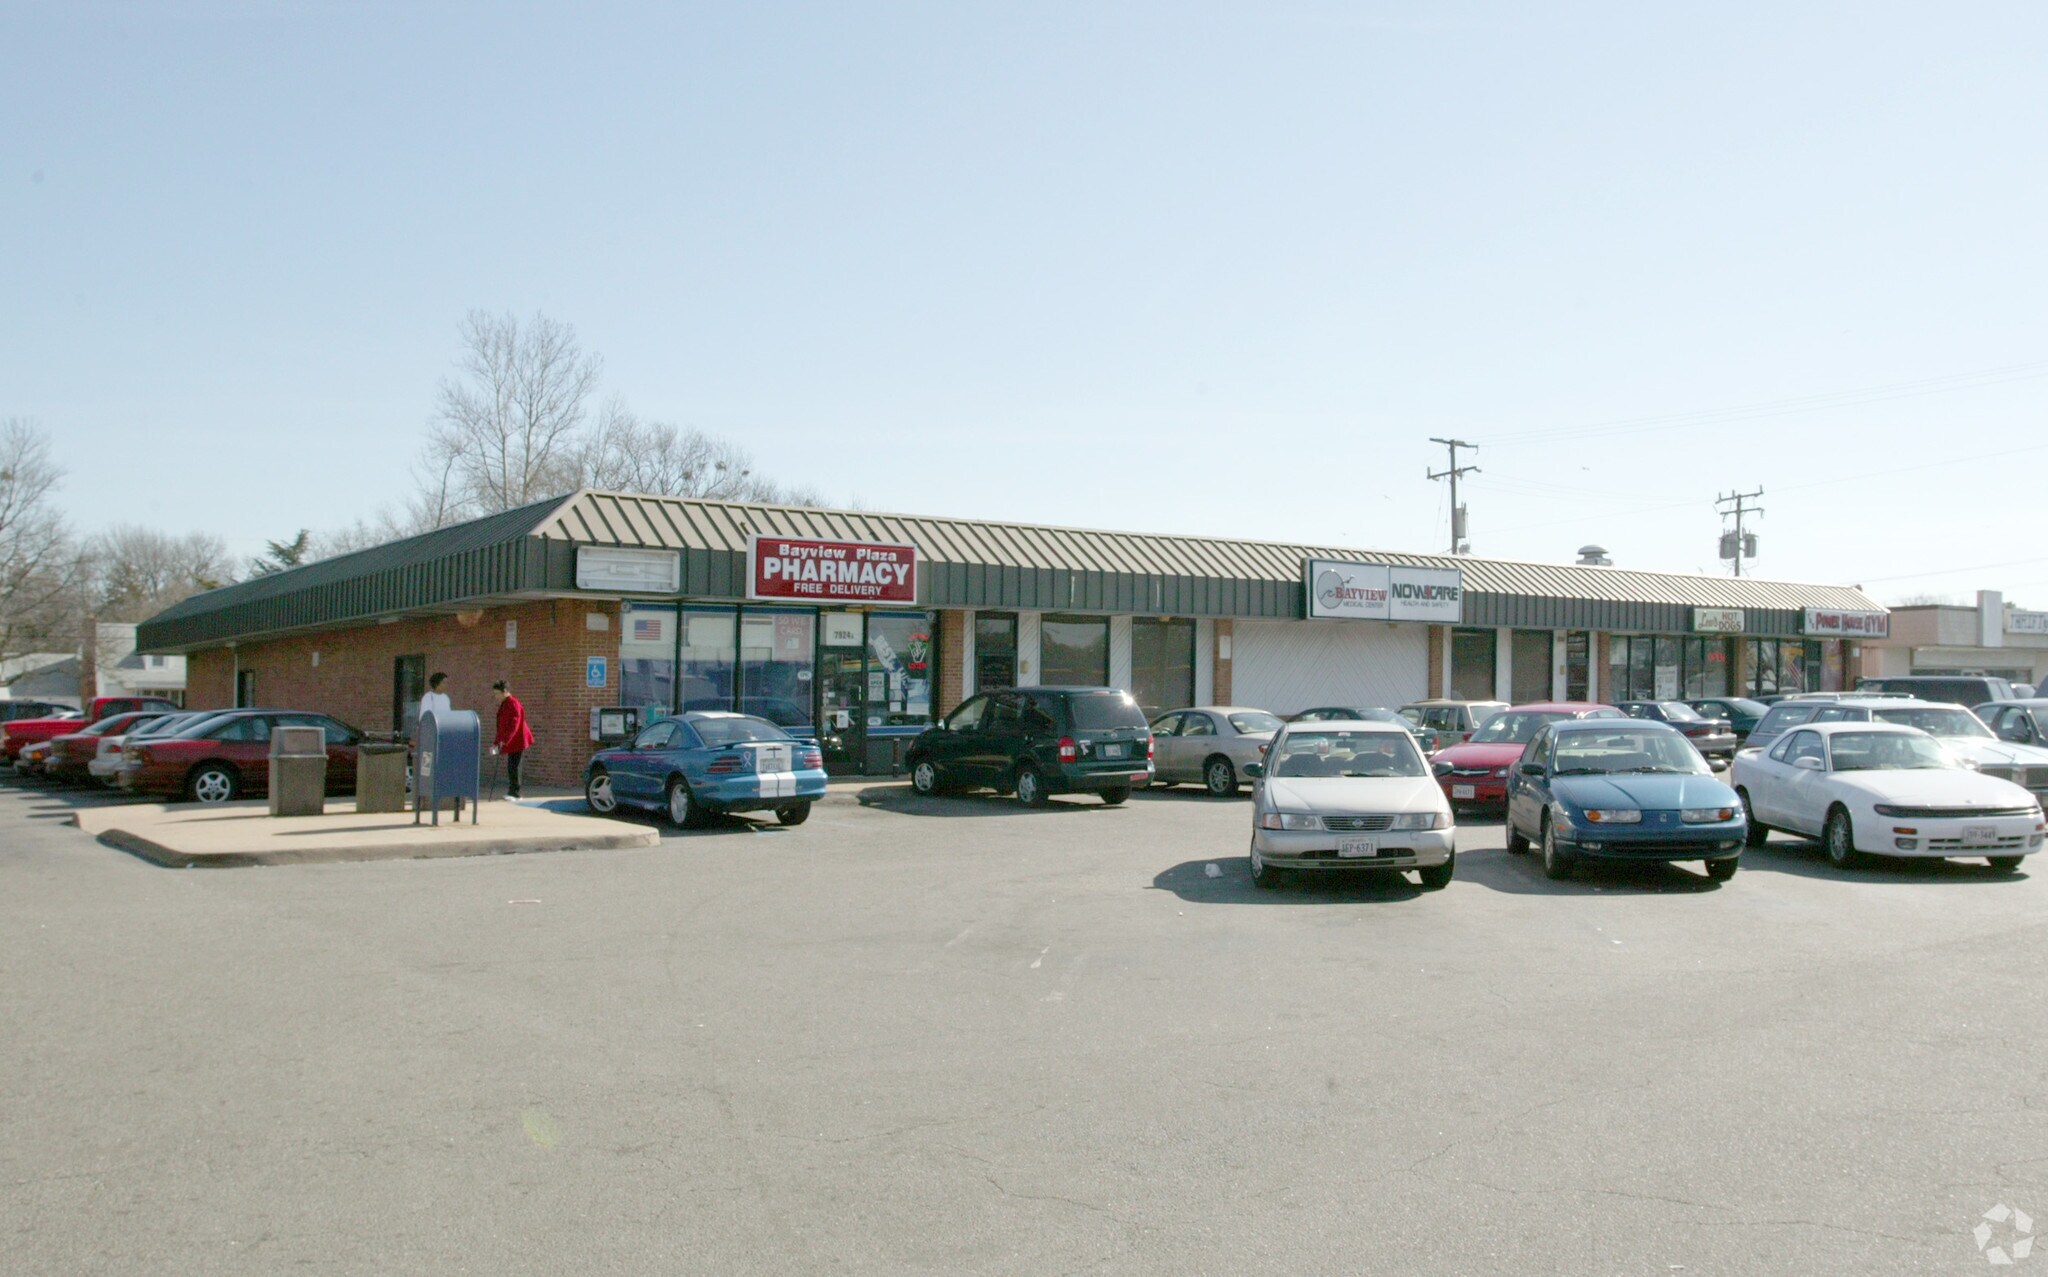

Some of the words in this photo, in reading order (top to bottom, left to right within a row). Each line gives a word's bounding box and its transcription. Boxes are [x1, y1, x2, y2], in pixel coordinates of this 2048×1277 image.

[779, 544, 846, 559] Bayview
[857, 548, 897, 561] Plaza
[763, 557, 910, 586] PHARMACY
[793, 583, 823, 593] FREE
[829, 584, 882, 596] DELIVERY
[1334, 586, 1388, 602] BAYVIEW
[1722, 611, 1737, 621] HOT
[1815, 612, 1840, 631] POWER
[1841, 613, 1863, 632] HOUSE
[1864, 615, 1886, 633] GYM
[1718, 621, 1741, 631] DOGS
